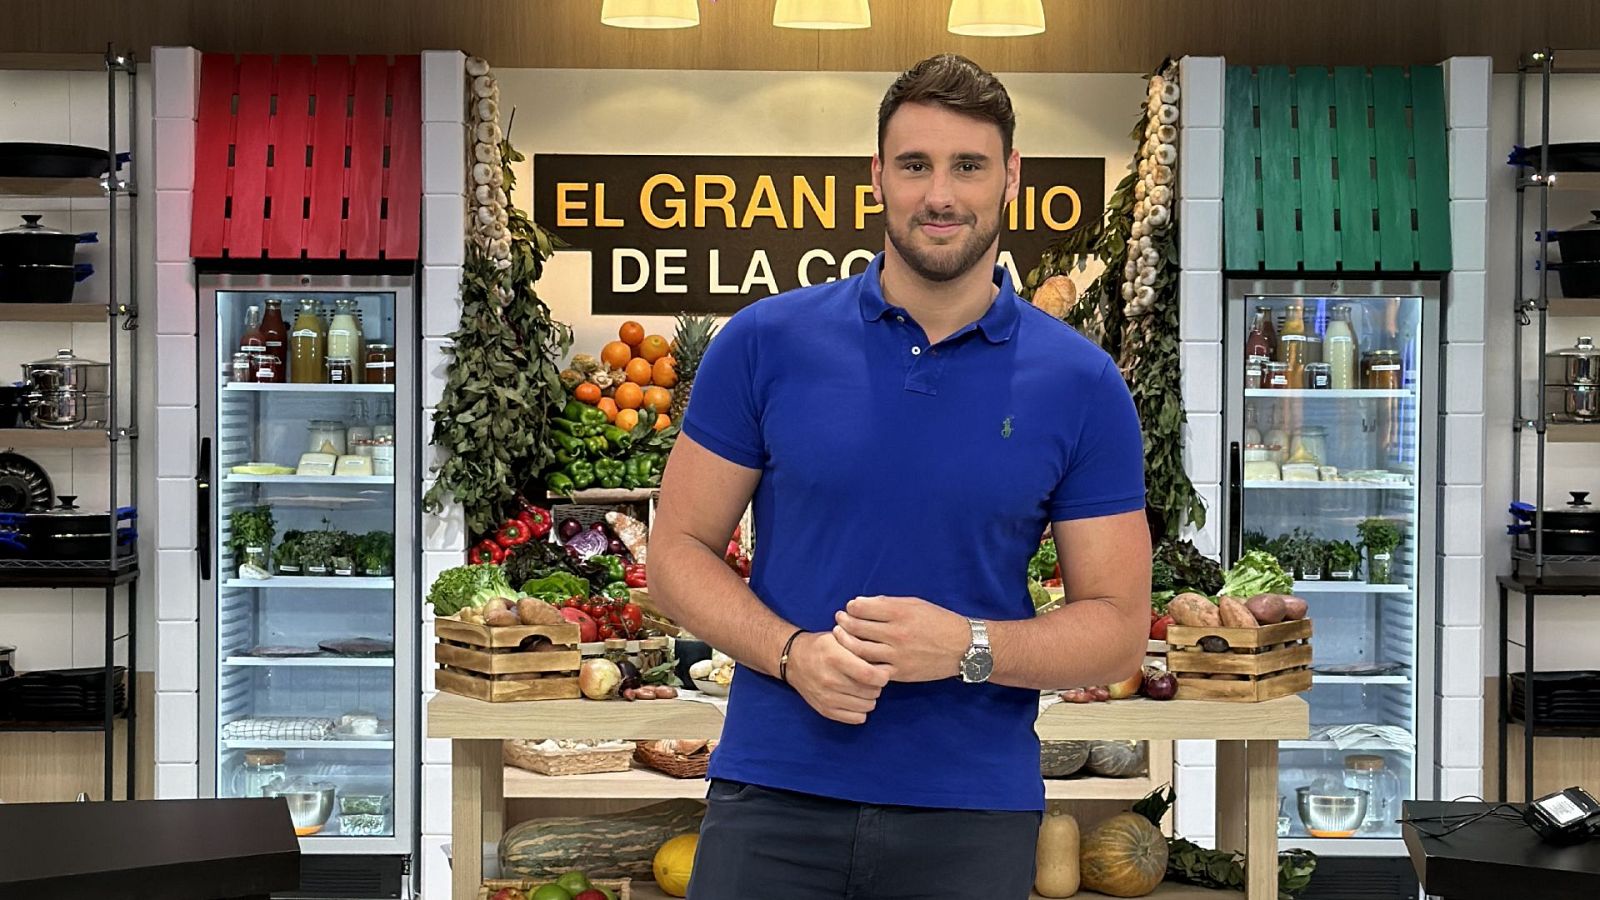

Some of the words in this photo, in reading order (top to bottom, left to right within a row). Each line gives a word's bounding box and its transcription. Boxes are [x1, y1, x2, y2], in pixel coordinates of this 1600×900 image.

[556, 182, 625, 227] EL
[639, 173, 836, 229] GRAN
[855, 184, 1082, 232] PIO
[612, 248, 688, 294] DE
[709, 249, 780, 294] LA
